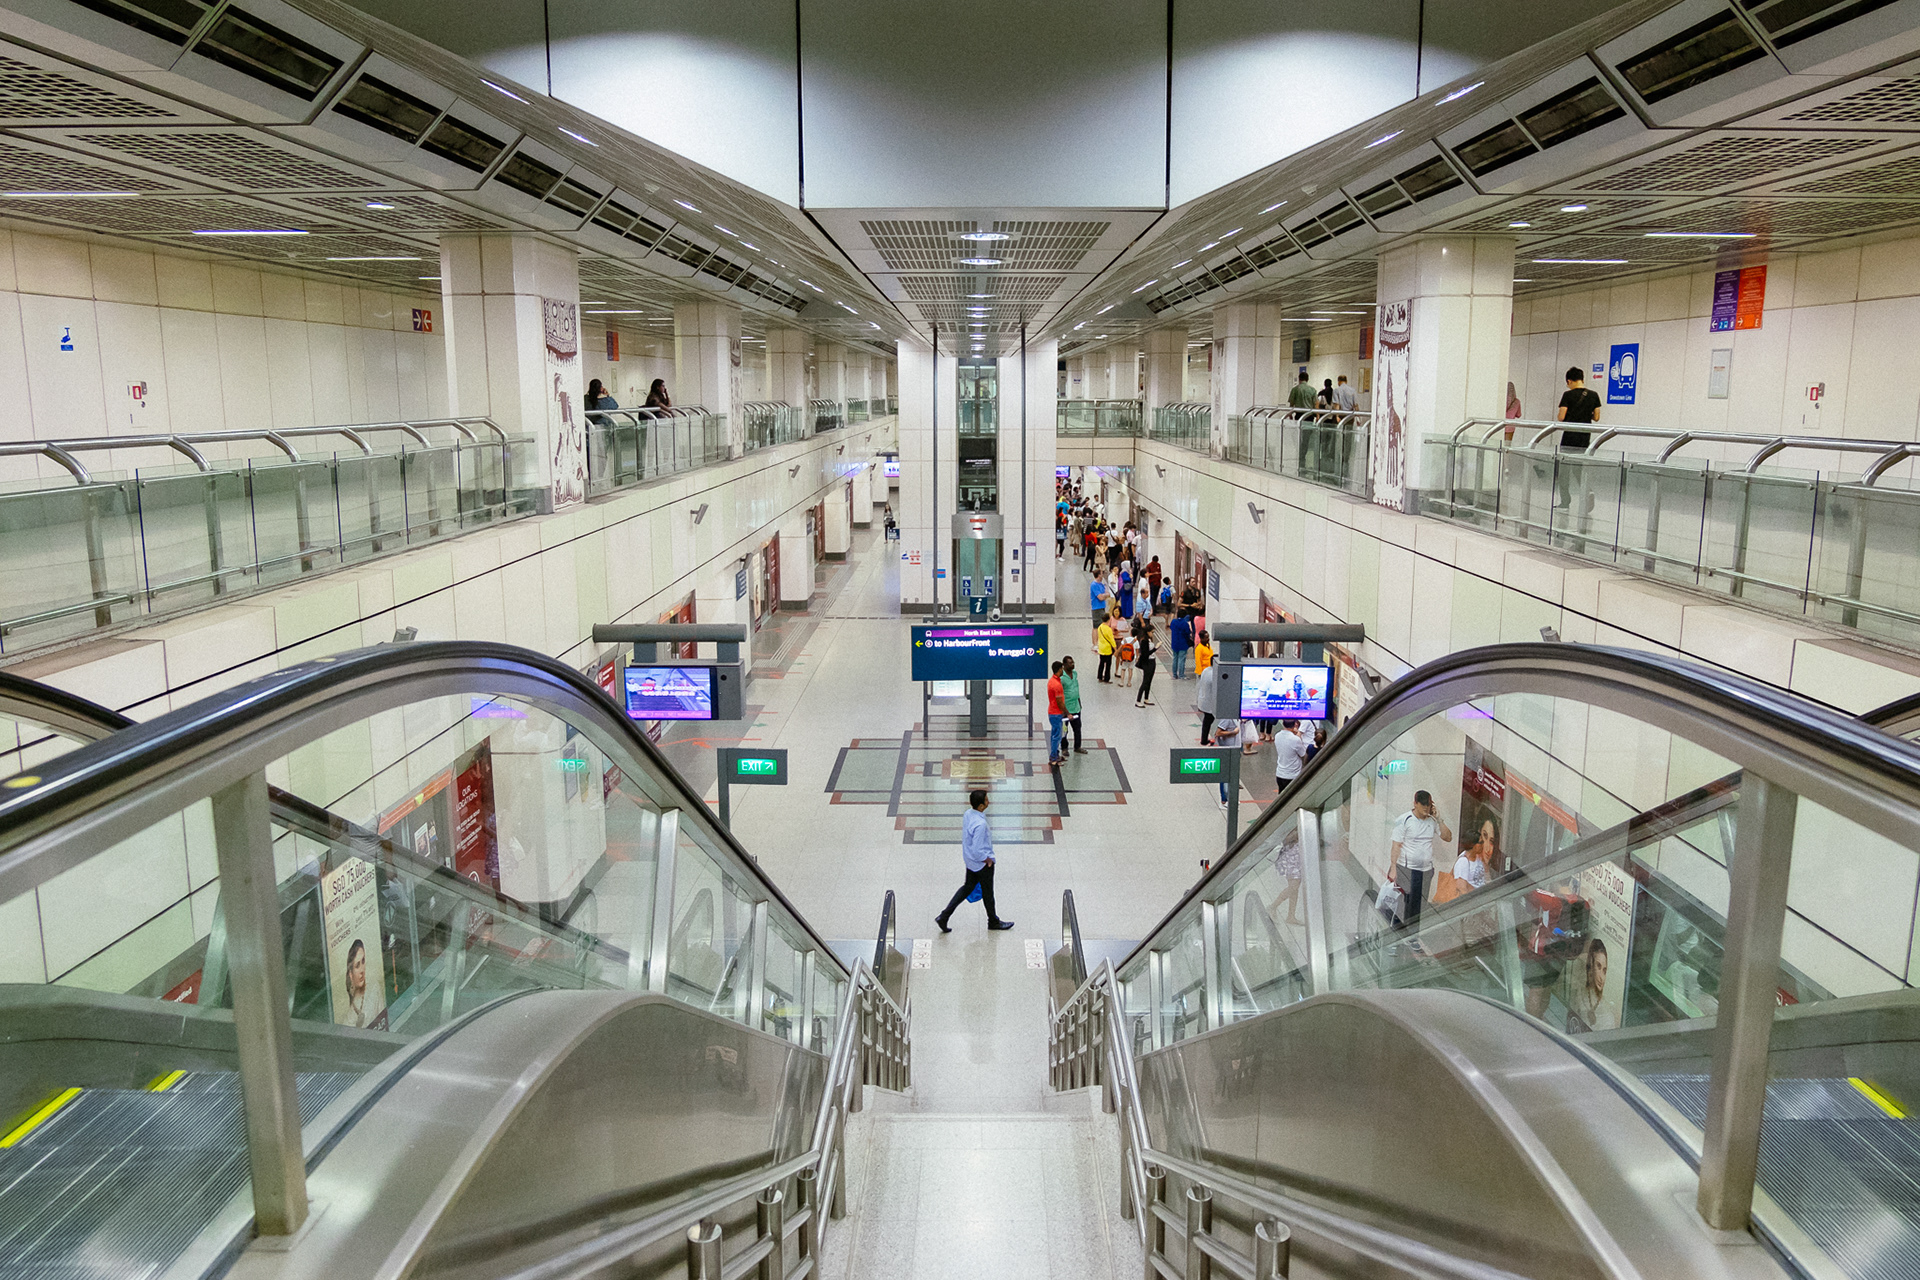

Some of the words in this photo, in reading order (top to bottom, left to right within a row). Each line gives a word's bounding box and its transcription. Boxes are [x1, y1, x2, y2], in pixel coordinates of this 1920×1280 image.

[943, 639, 990, 647] HarbourFront
[997, 648, 1026, 657] Punggol
[741, 760, 763, 771] EXIT
[1195, 760, 1217, 771] EXIT
[455, 789, 478, 812] LOCATIONS
[332, 874, 346, 896] SGD
[324, 895, 342, 916] WORTH
[341, 888, 354, 903] CASH
[353, 868, 375, 893] VOUCHERS
